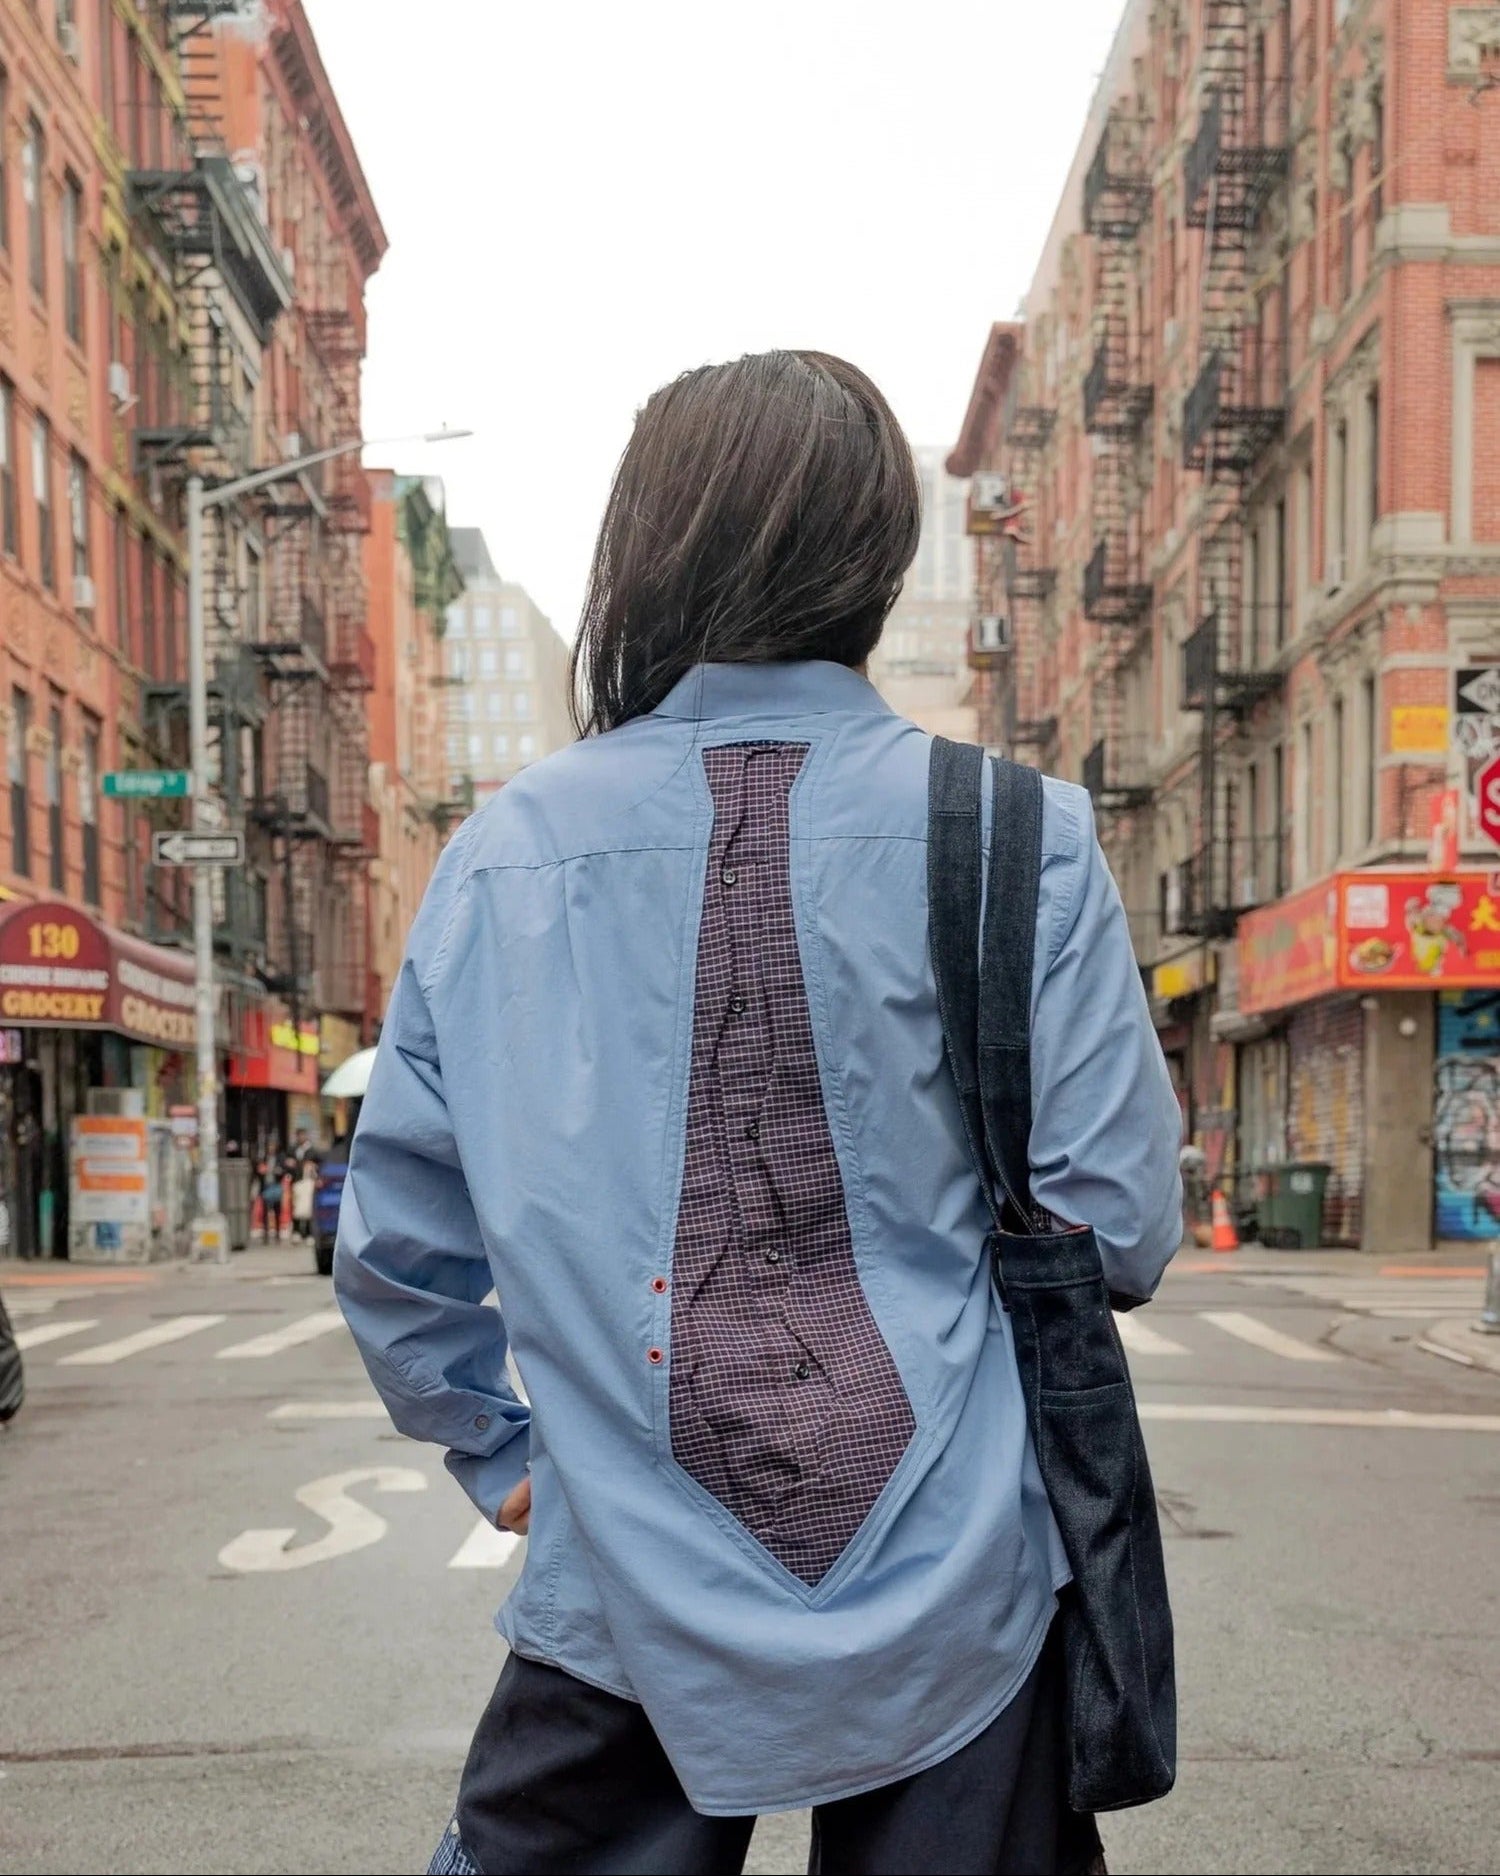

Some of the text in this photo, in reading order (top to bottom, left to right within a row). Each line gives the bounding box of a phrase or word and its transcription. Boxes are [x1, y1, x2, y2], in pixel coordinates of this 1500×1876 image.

[29, 922, 79, 960] 130
[3, 990, 105, 1020] GROCERY
[121, 995, 197, 1043] GROCER
